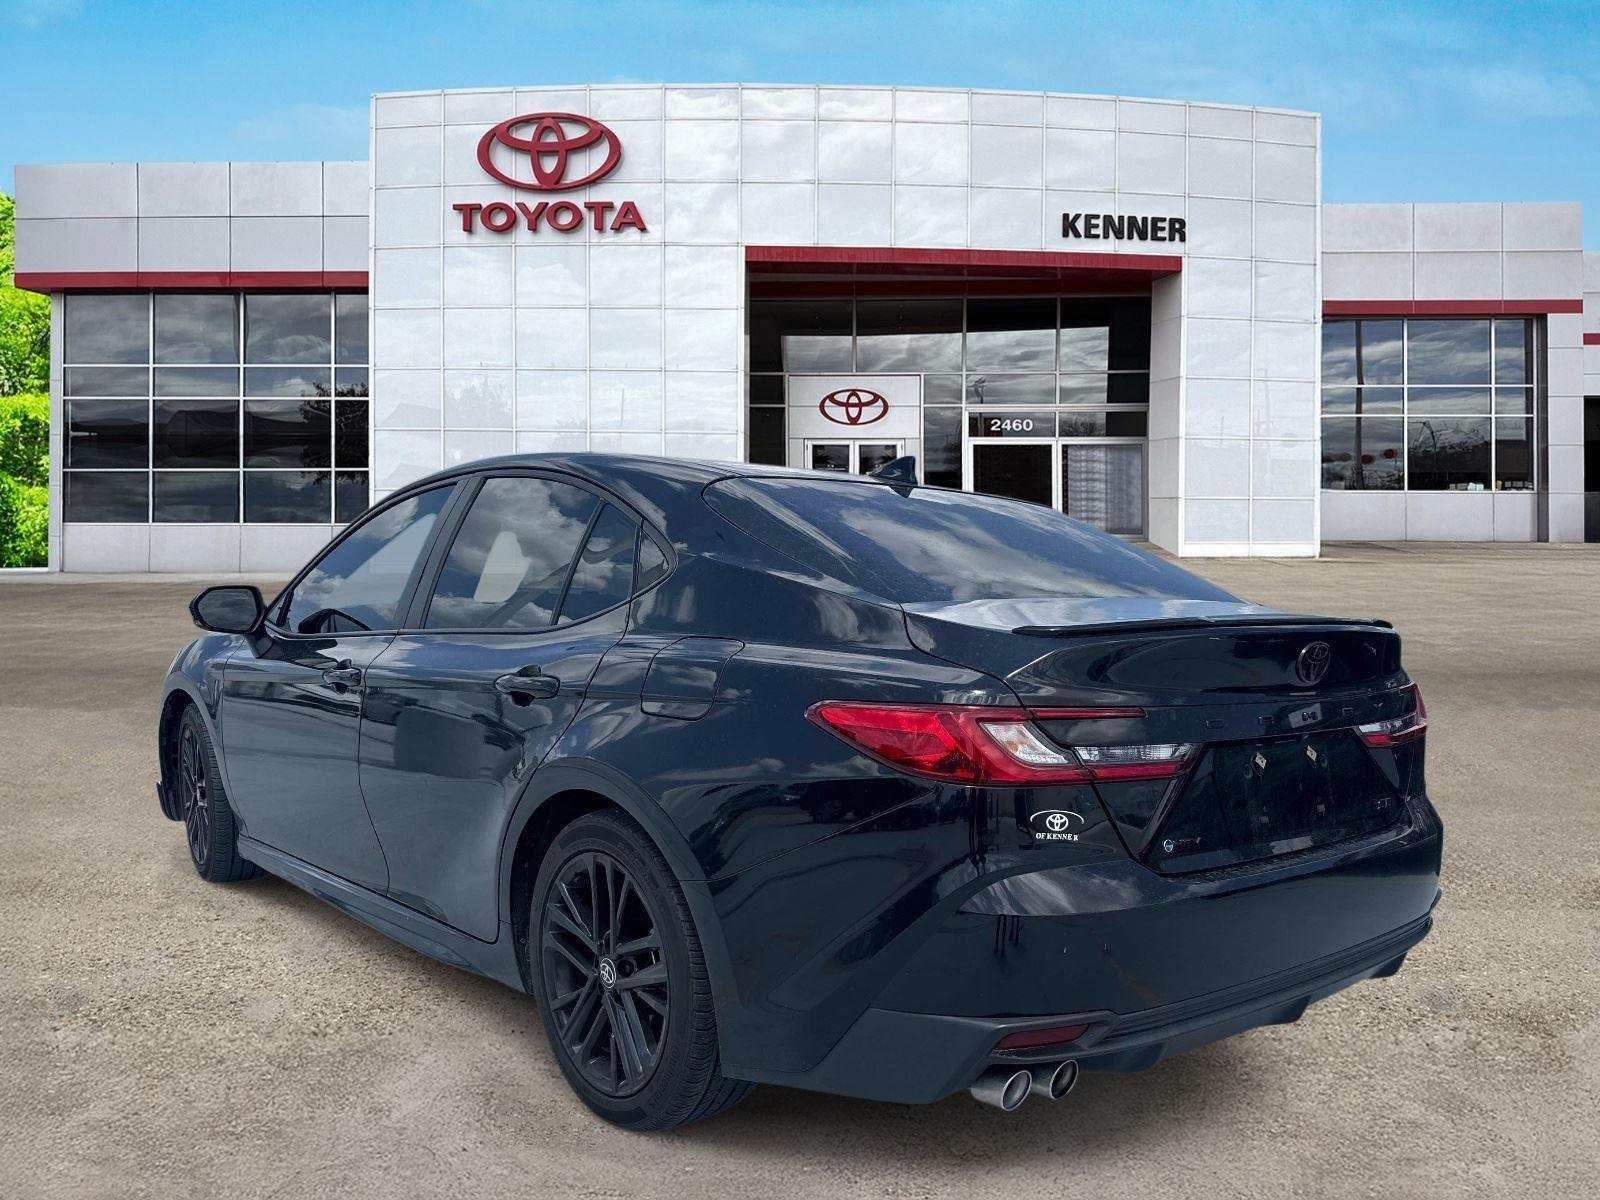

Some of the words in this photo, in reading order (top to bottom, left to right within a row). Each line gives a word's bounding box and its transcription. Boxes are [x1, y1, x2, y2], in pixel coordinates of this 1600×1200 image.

[452, 201, 647, 233] TOYOTA
[1062, 213, 1187, 242] KENNER
[990, 418, 1034, 431] 2460
[1035, 832, 1046, 840] OF
[1046, 832, 1079, 842] KENNER
